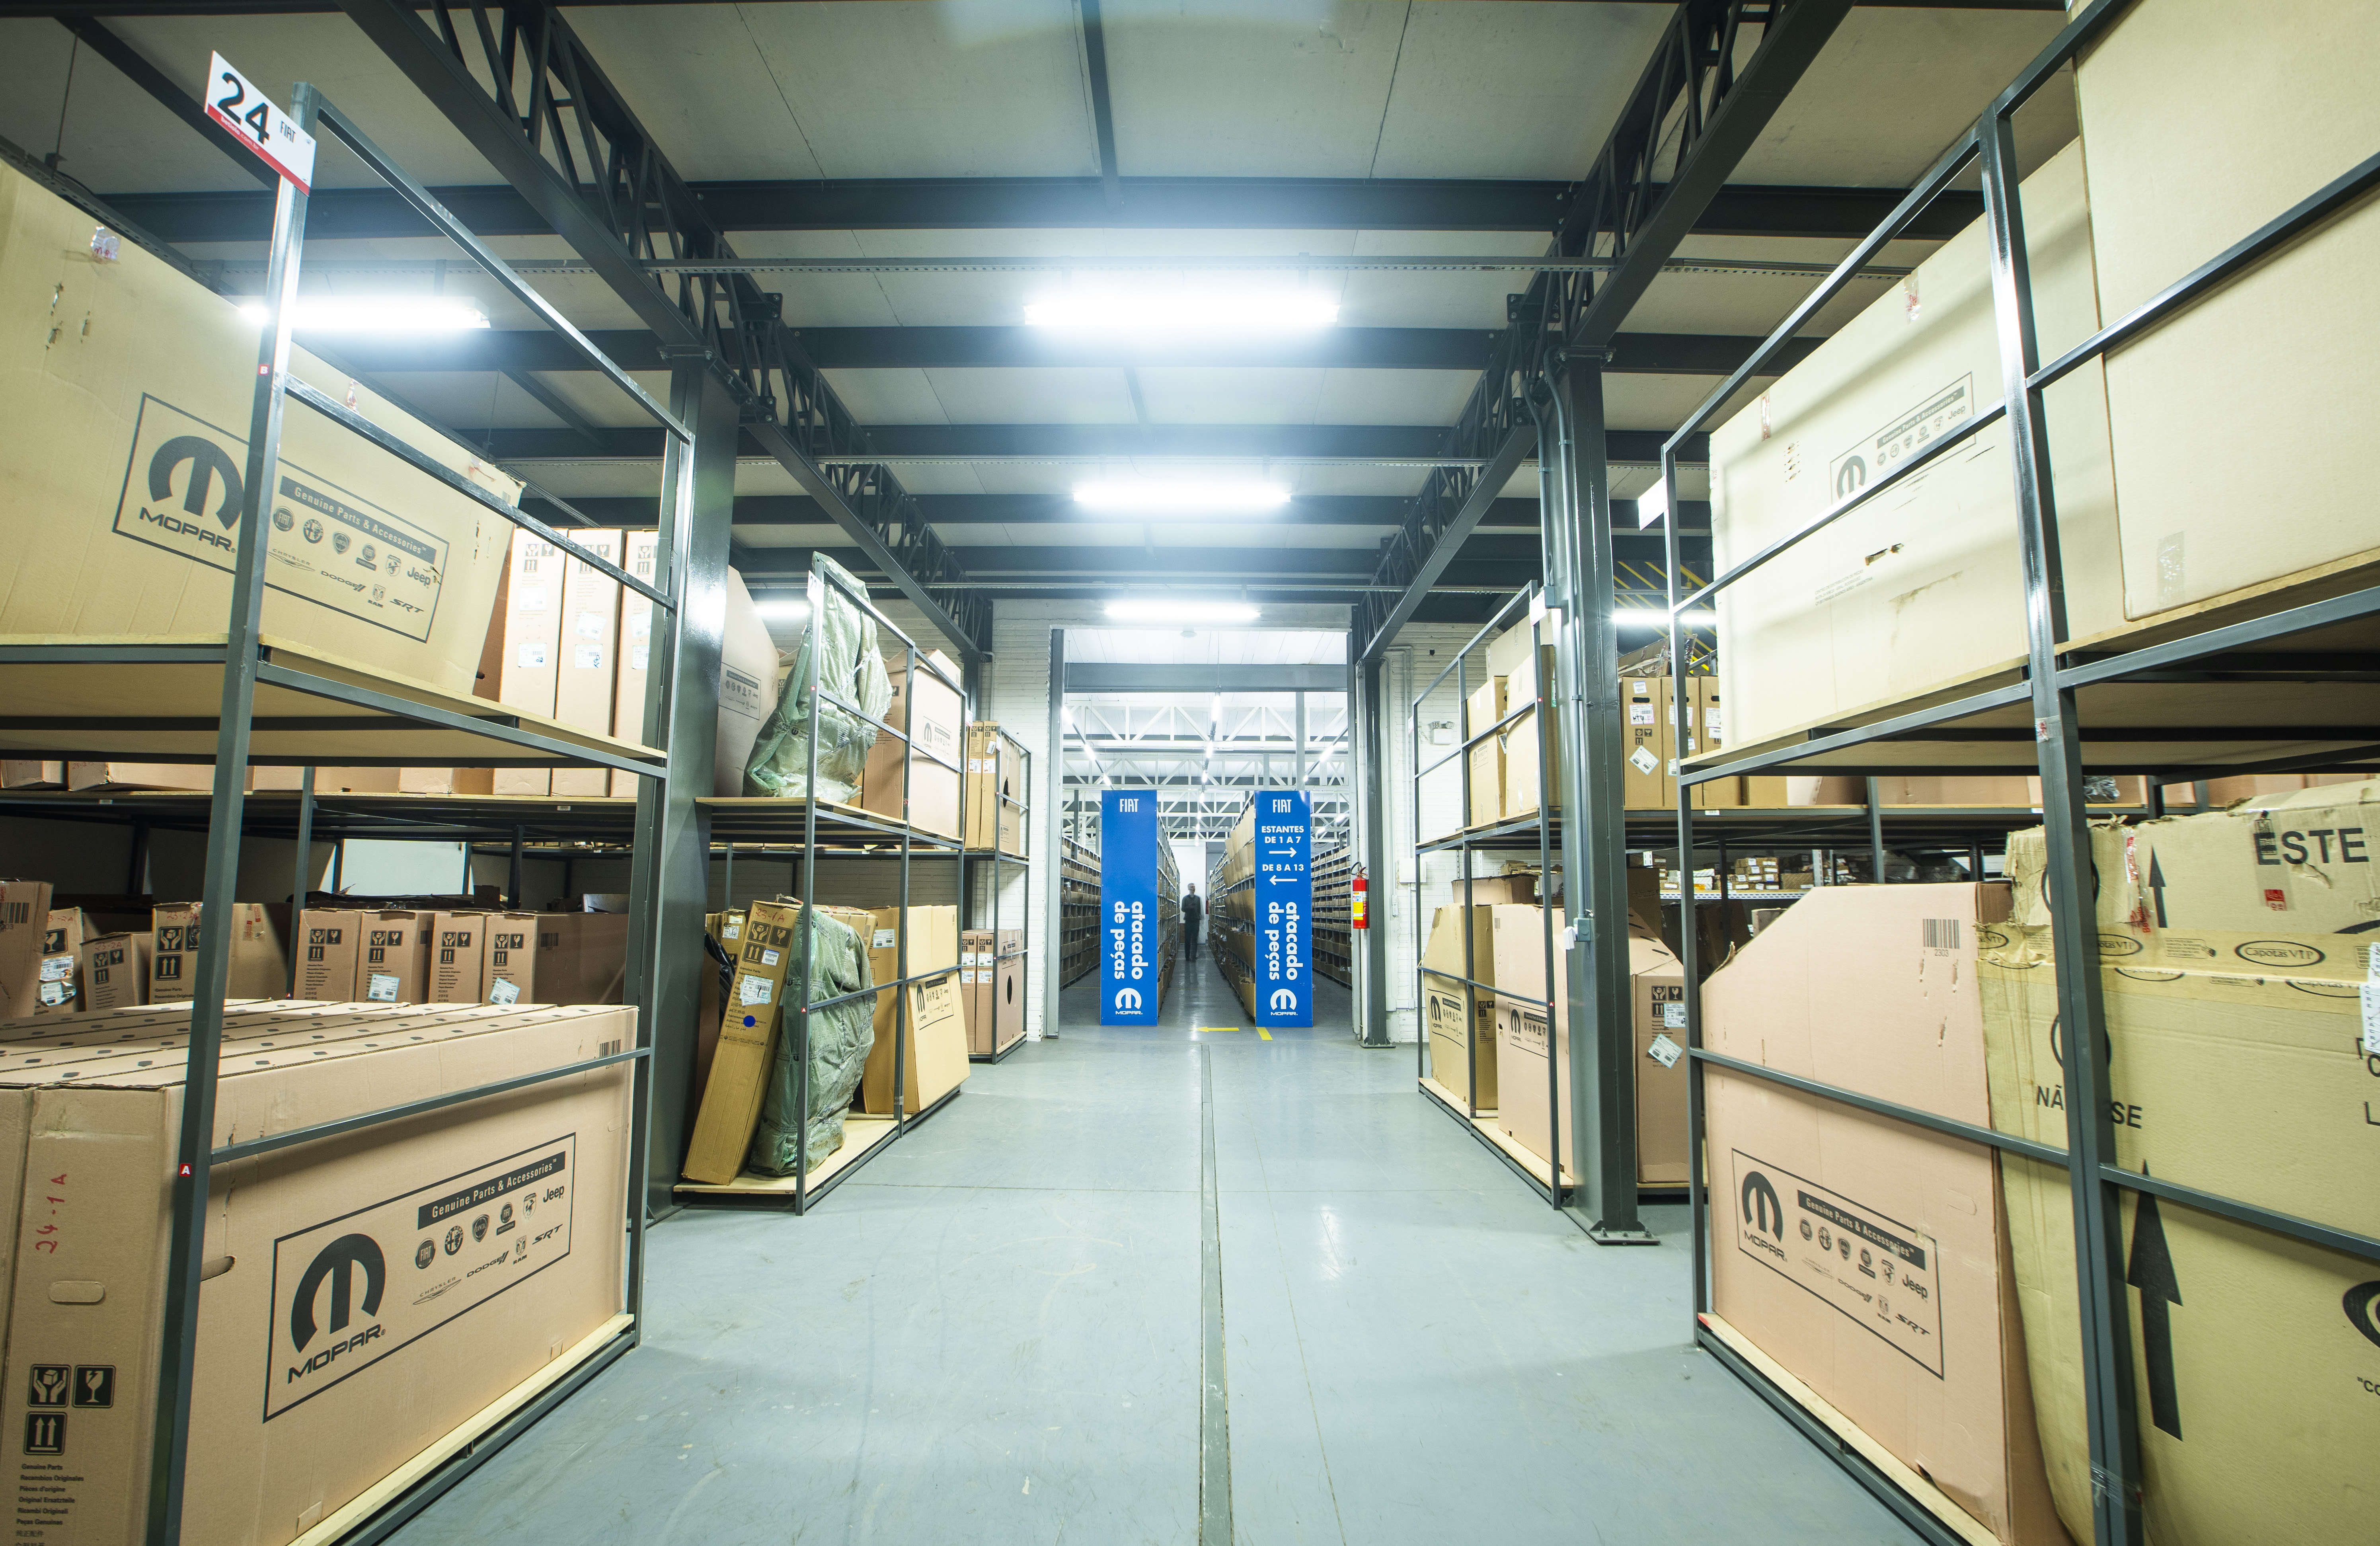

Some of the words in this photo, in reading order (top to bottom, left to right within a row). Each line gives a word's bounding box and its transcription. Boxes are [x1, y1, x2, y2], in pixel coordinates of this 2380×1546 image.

[218, 72, 270, 145] 24
[280, 120, 296, 143] FIAT
[260, 366, 268, 374] B
[1948, 406, 1965, 420] Jeep
[1883, 428, 1902, 443] Genuine
[1902, 420, 1916, 431] Parts
[278, 511, 291, 523] FIAT
[294, 487, 334, 512] Genuine
[337, 507, 361, 525] Parts
[363, 519, 370, 529] &
[272, 549, 310, 566] CHRYSLER
[320, 570, 363, 591] DODGE
[407, 567, 431, 587] Jeep
[367, 599, 384, 608] RAM
[390, 598, 425, 613] SRT
[1119, 798, 1139, 812] FIAT
[1273, 799, 1292, 813] FIAT
[2253, 827, 2370, 865] ESTE
[1114, 901, 1130, 924] de
[1269, 901, 1284, 924] de
[1131, 901, 1148, 980] atacado
[1286, 901, 1303, 980] atacado
[2115, 941, 2134, 950] VIP
[1110, 929, 1125, 980] peças
[1265, 929, 1280, 980] peças
[2245, 947, 2288, 958] Capotas
[2288, 949, 2314, 960] VIP
[2037, 1084, 2065, 1111] NÃ
[181, 1165, 191, 1175] A
[432, 1195, 470, 1218] Genuine
[473, 1185, 495, 1201] Parts
[497, 1180, 505, 1191] &
[543, 1185, 565, 1203] Jeep
[1806, 1197, 1833, 1219] Genuine
[1835, 1210, 1853, 1228] Parts
[1854, 1221, 1861, 1232] &
[532, 1223, 563, 1245] SRT
[419, 1245, 432, 1261] FIAT
[513, 1254, 528, 1265] RAM
[466, 1254, 505, 1278] DODGE
[1805, 1257, 1830, 1273] CHRYSLER
[419, 1276, 456, 1297] CHRYSLER
[1838, 1278, 1868, 1300] DODGE
[1902, 1274, 1928, 1300] Jeep
[1877, 1312, 1892, 1324] RAM
[1895, 1313, 1931, 1335] SRT
